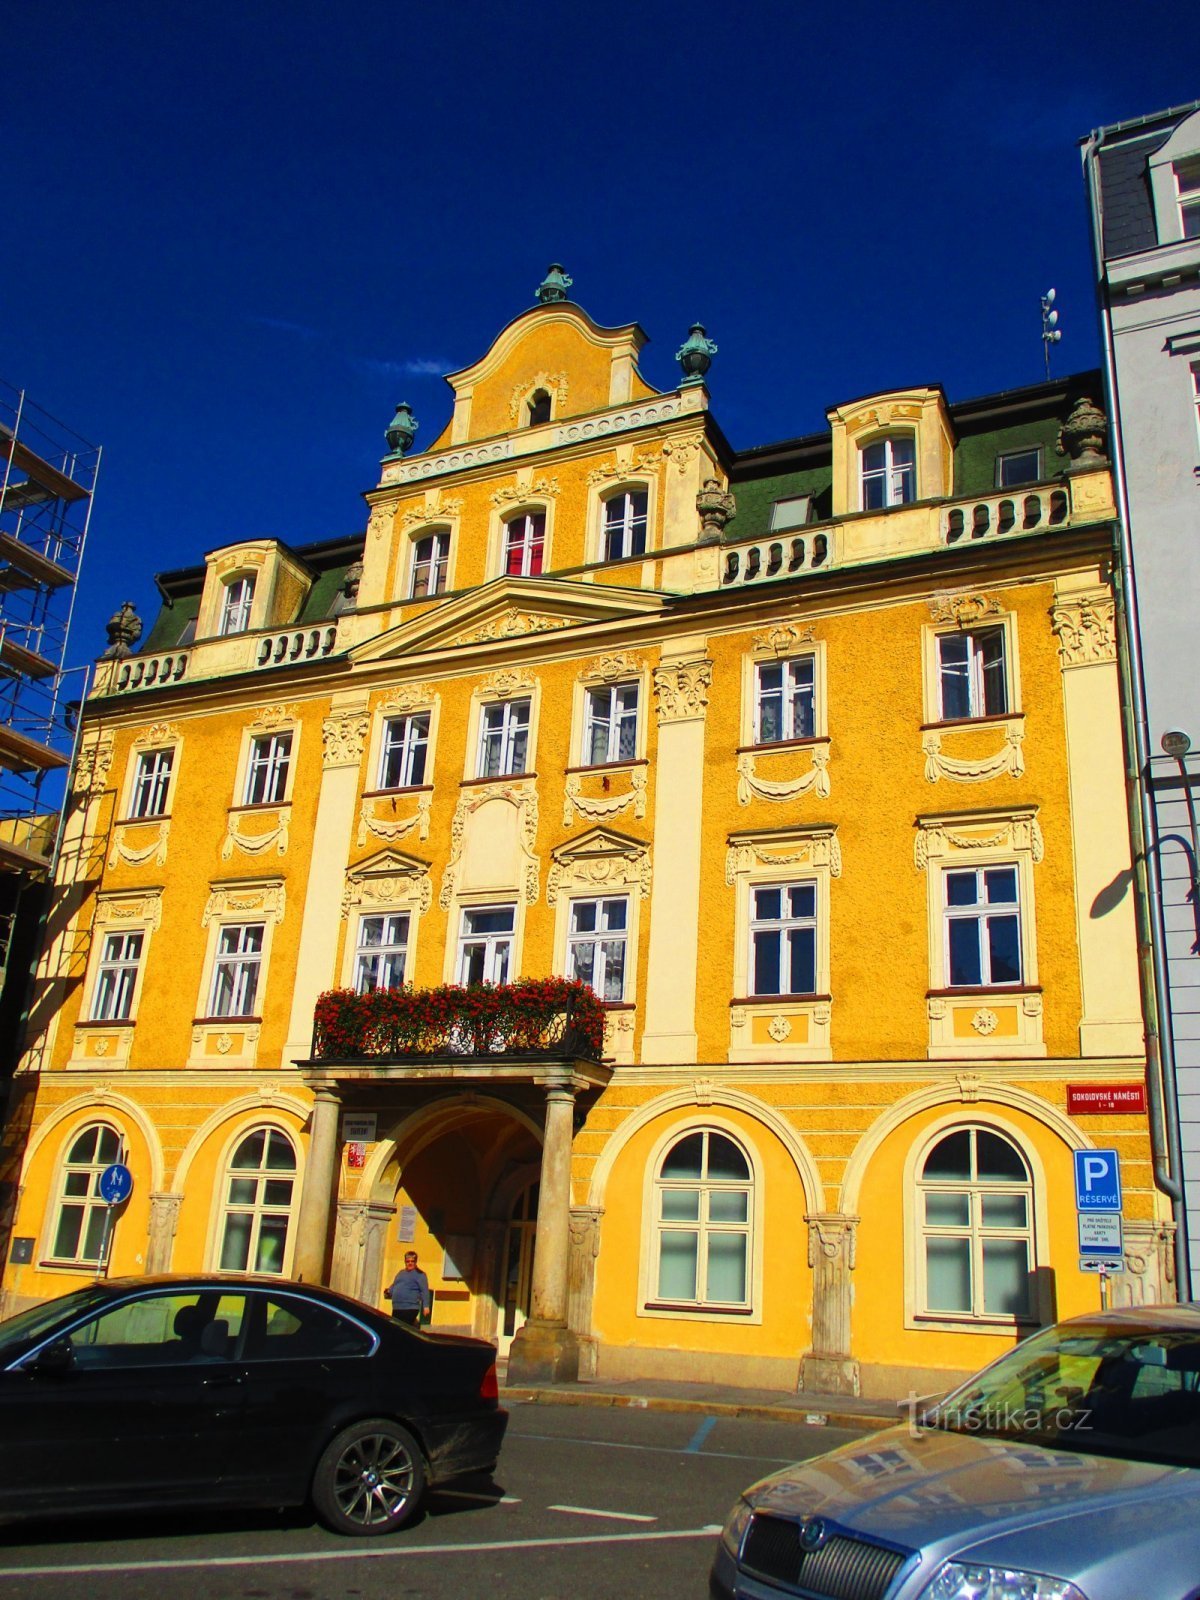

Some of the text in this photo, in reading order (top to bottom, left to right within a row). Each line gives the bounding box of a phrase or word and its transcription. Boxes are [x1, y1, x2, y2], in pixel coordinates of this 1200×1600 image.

[1072, 1091, 1140, 1101] SOKOLOVSKÉ NÁMĚSTÍ
[1084, 1157, 1109, 1191] P
[1080, 1193, 1118, 1204] RÉSERVÉ
